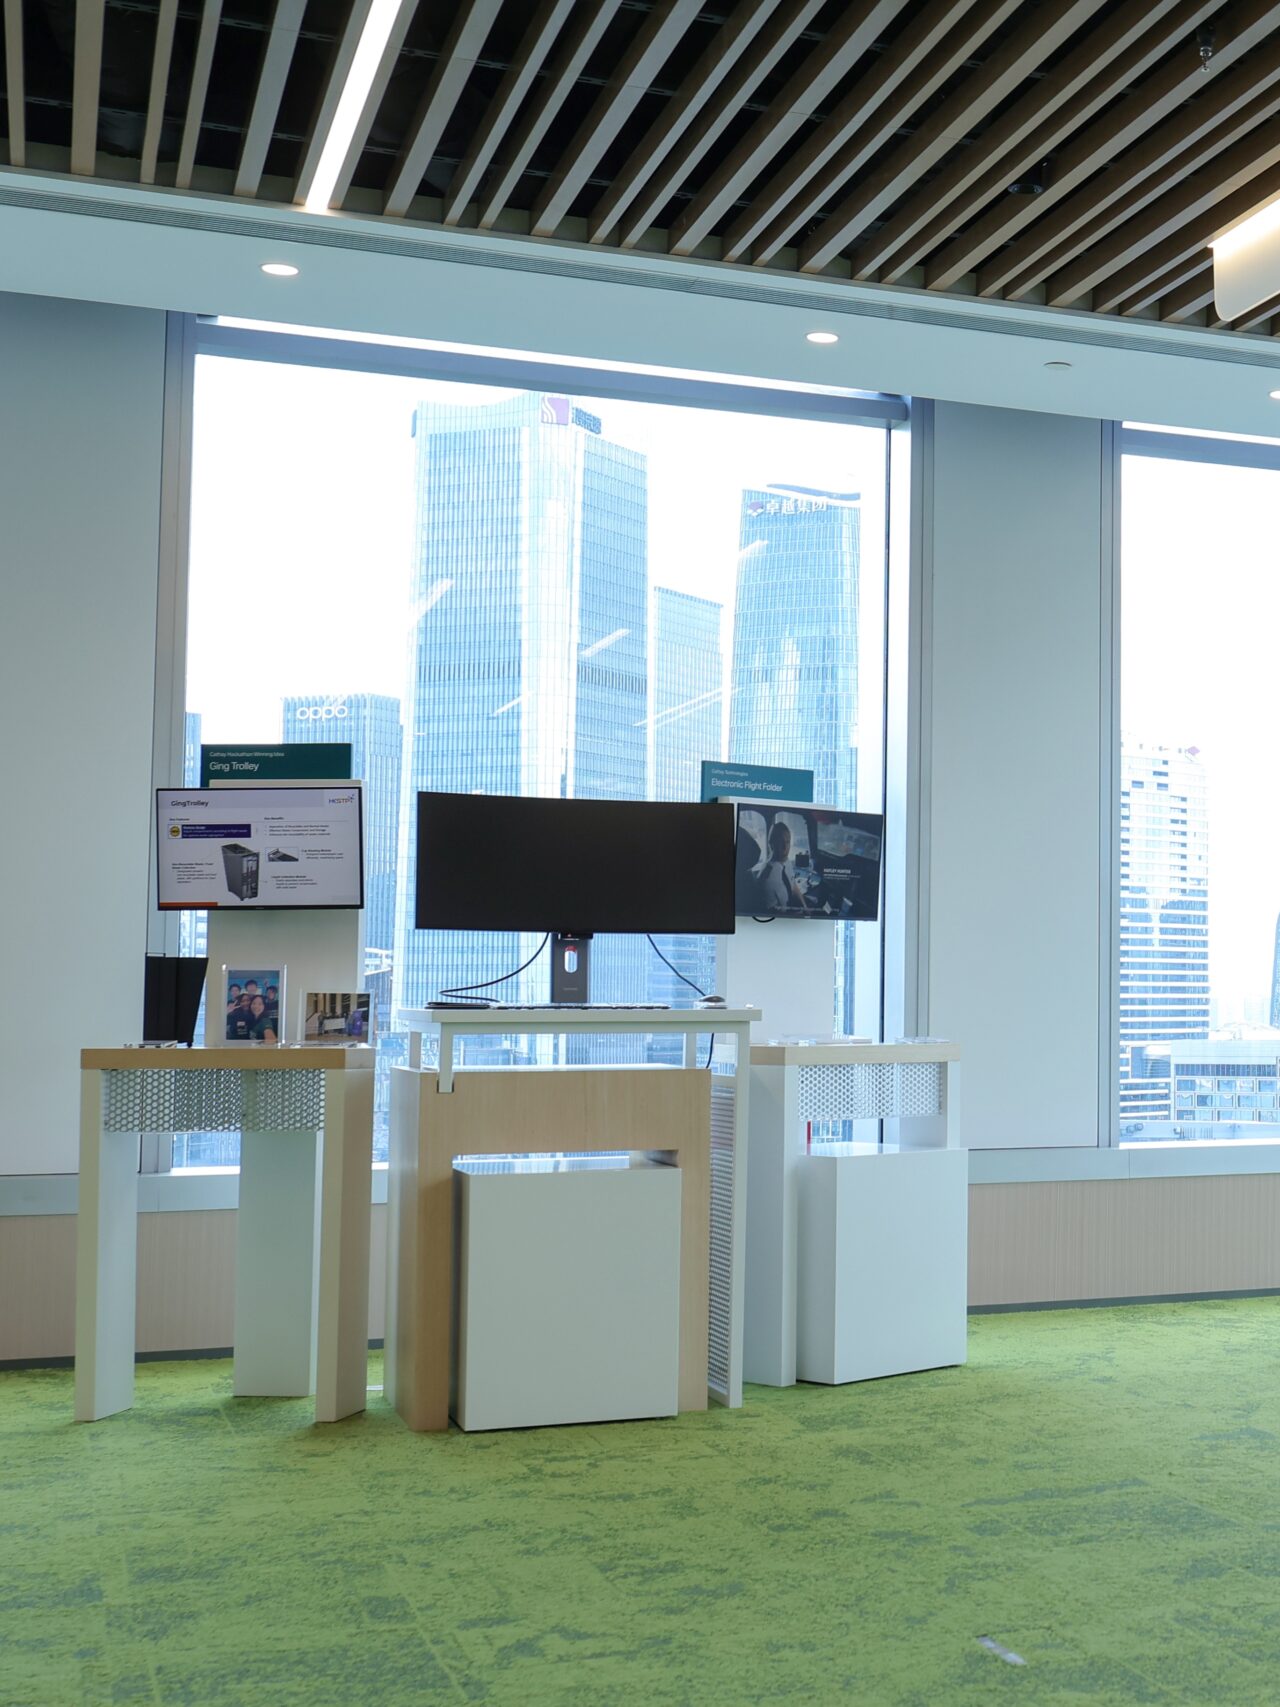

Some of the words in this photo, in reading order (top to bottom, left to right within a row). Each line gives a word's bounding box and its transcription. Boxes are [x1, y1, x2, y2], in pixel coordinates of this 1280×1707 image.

[766, 499, 828, 515] 卓越集团
[209, 761, 230, 772] Ging
[232, 761, 260, 772] Trolley
[711, 777, 744, 789] Electronic
[744, 780, 762, 791] Flight
[762, 782, 784, 792] Folder
